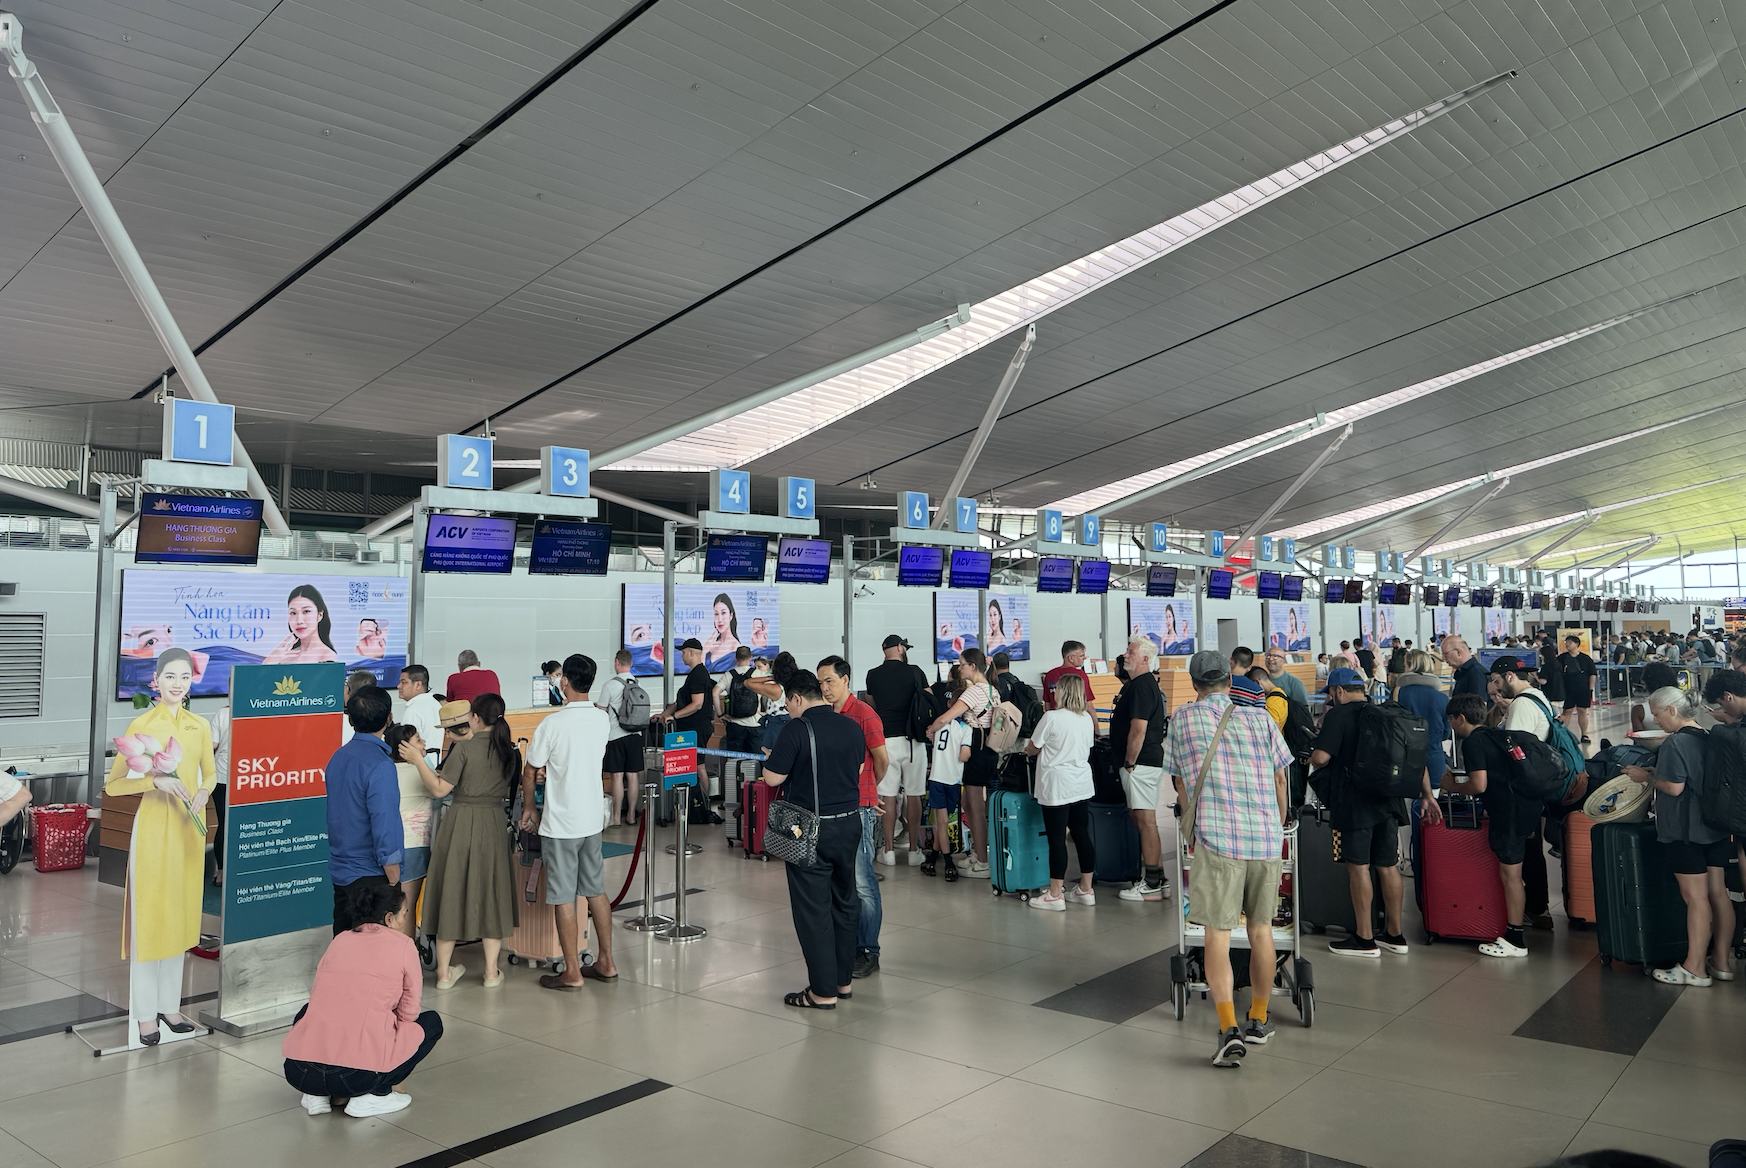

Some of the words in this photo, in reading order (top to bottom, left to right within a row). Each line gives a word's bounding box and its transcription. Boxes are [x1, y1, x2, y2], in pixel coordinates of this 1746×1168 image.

[193, 414, 208, 449] 1
[461, 447, 480, 478] 2
[562, 458, 579, 487] 3
[728, 479, 741, 504] 4
[796, 486, 808, 510] 5
[913, 500, 923, 521] 6
[962, 505, 972, 525] 7
[165, 524, 189, 533] HẠNG
[190, 525, 223, 534] THƯƠNG
[435, 526, 469, 539] ACV
[1050, 516, 1058, 535] 8
[1087, 520, 1095, 538] 9
[175, 533, 207, 543] Business
[208, 535, 227, 543] Class
[1154, 529, 1165, 546] 10
[1213, 536, 1222, 552] 11
[784, 547, 803, 557] ACV
[1263, 541, 1272, 556] 12
[1286, 544, 1295, 559] 13
[905, 554, 921, 563] ACV
[956, 557, 971, 566] ACV
[1044, 564, 1056, 573] ACV
[1083, 566, 1095, 575] ACV
[1152, 571, 1163, 579] ACV
[184, 603, 231, 623] Nâng
[938, 729, 949, 751] 9
[237, 756, 280, 774] SKY
[665, 765, 691, 774] PRIORITY
[236, 768, 326, 791] PRIORITY
[239, 829, 267, 839] Business
[293, 843, 317, 852] Member
[291, 885, 316, 895] Member
